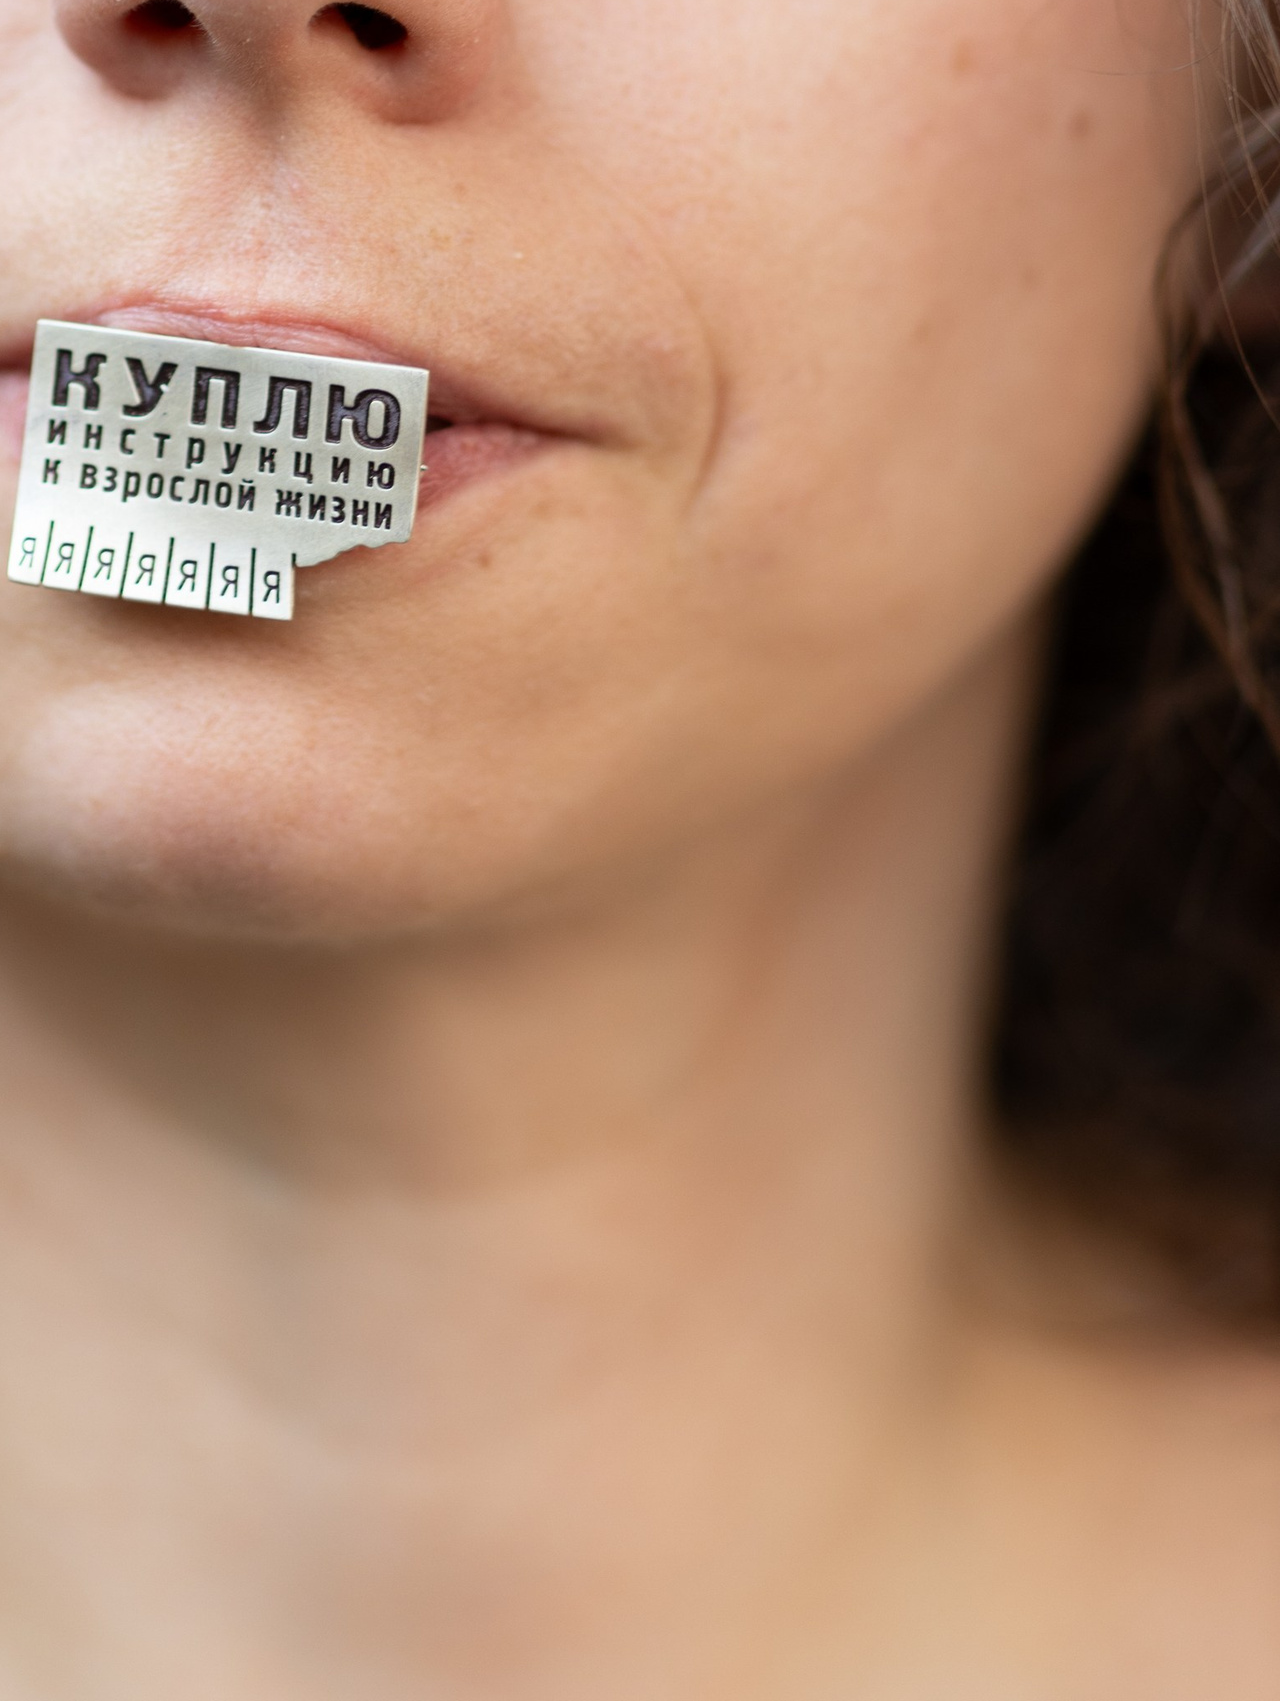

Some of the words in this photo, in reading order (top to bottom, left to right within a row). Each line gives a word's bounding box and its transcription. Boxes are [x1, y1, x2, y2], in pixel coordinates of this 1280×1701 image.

[51, 349, 401, 449] КУПЛЮ
[79, 463, 256, 511] взрослой
[275, 489, 392, 530] жизни
